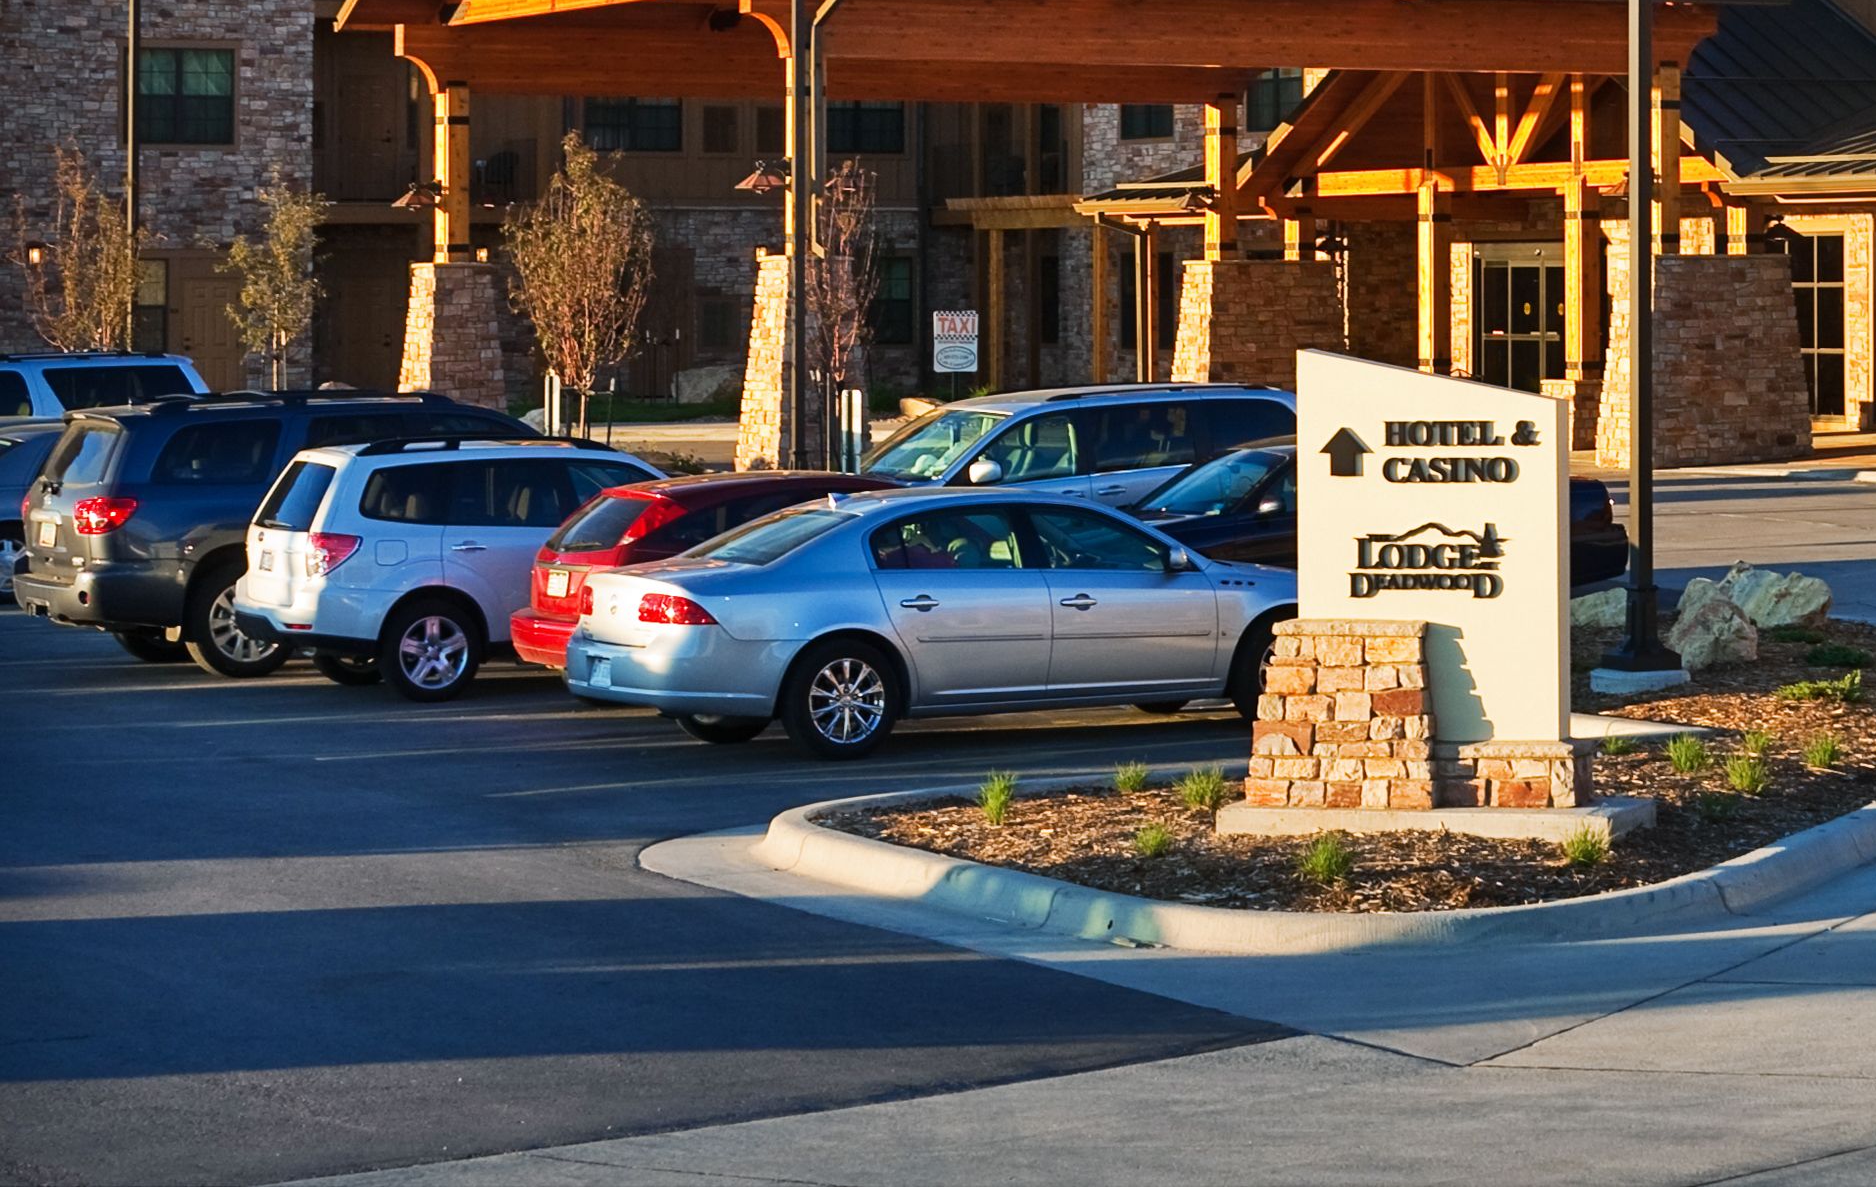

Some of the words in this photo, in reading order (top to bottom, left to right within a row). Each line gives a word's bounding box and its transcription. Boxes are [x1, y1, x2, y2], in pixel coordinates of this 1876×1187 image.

[938, 316, 977, 334] TAXI
[1383, 420, 1505, 446] HOTEL
[1511, 420, 1541, 446] &
[1382, 456, 1520, 484] CASINO
[1354, 537, 1488, 570] LODGE
[1347, 572, 1504, 599] DEADWOOD
